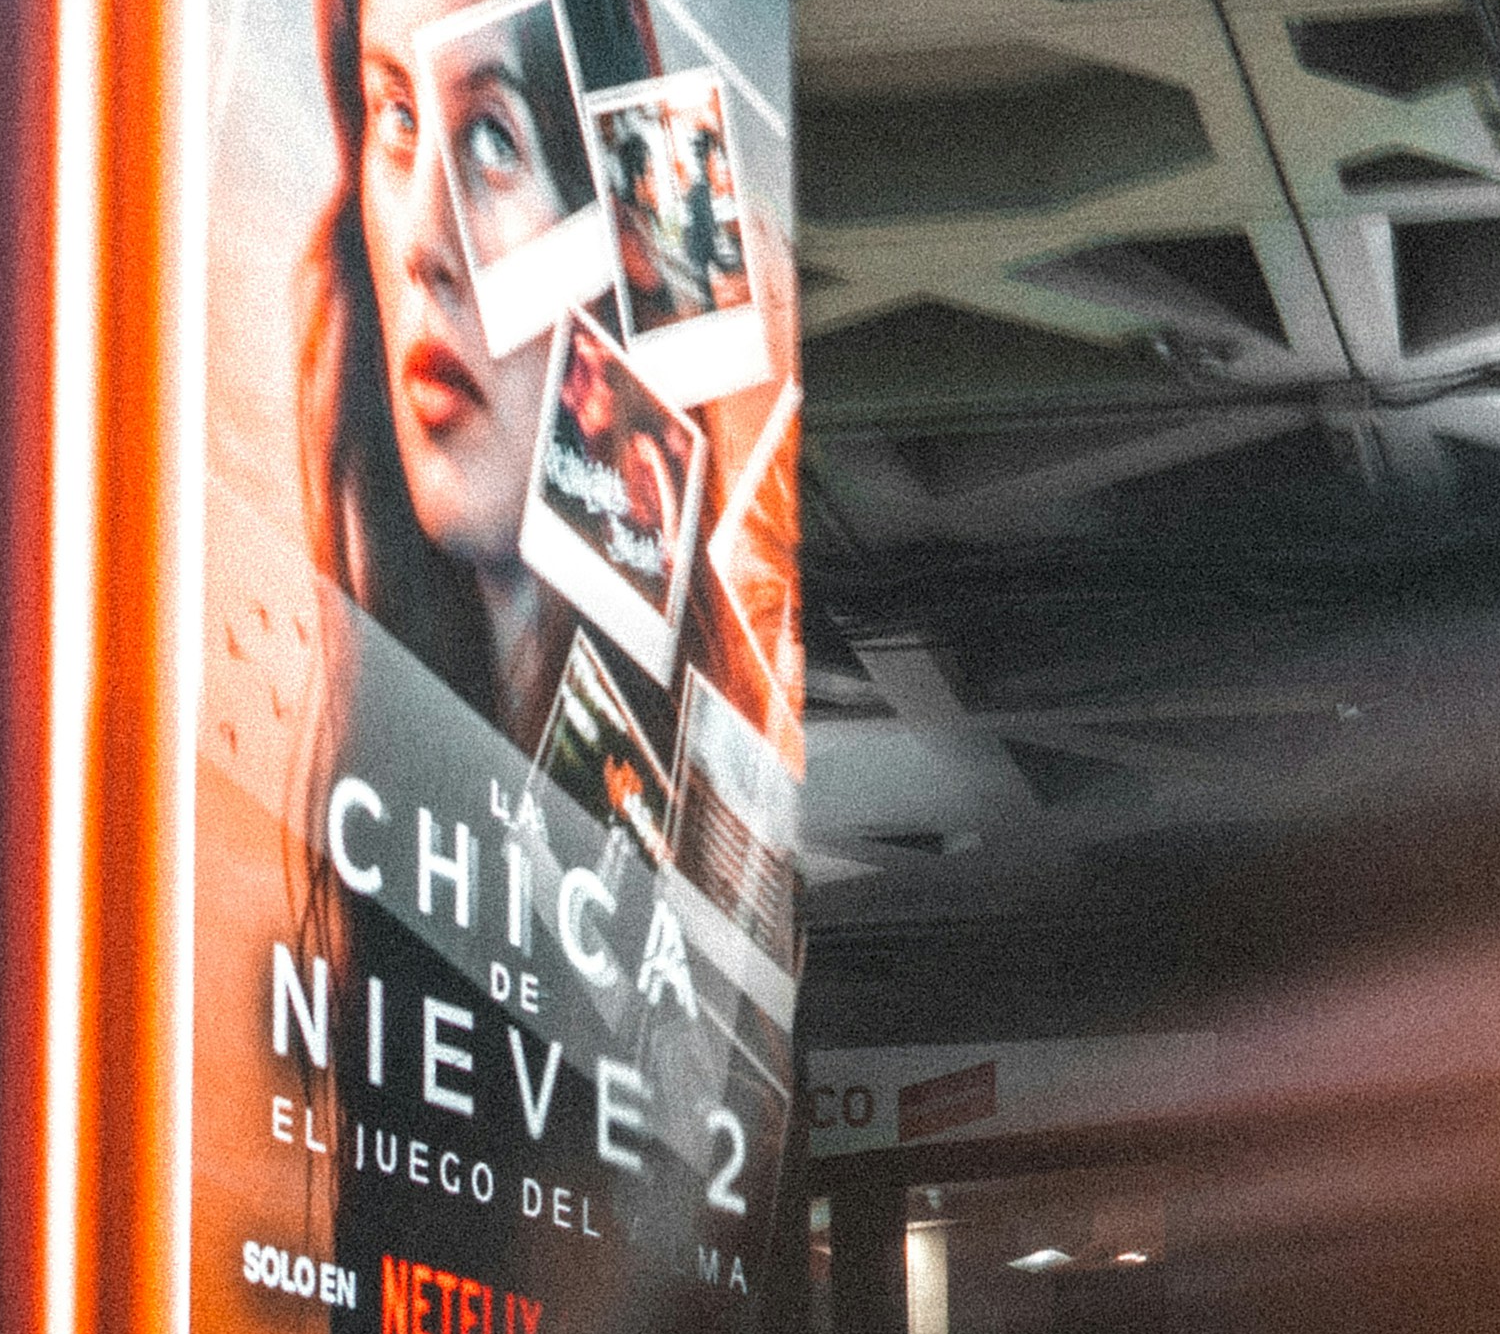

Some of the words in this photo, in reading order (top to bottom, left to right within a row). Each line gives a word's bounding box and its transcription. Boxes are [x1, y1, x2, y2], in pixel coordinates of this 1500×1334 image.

[491, 779, 547, 837] LA
[328, 777, 698, 1020] CHICA
[491, 961, 540, 1014] DE
[273, 941, 651, 1173] NIEVE
[706, 1110, 747, 1216] 2
[272, 1096, 328, 1154] EL
[356, 1123, 495, 1204] JUEGO
[522, 1177, 602, 1239] DEL
[242, 1239, 316, 1299] SOLO
[319, 1266, 357, 1310] EN
